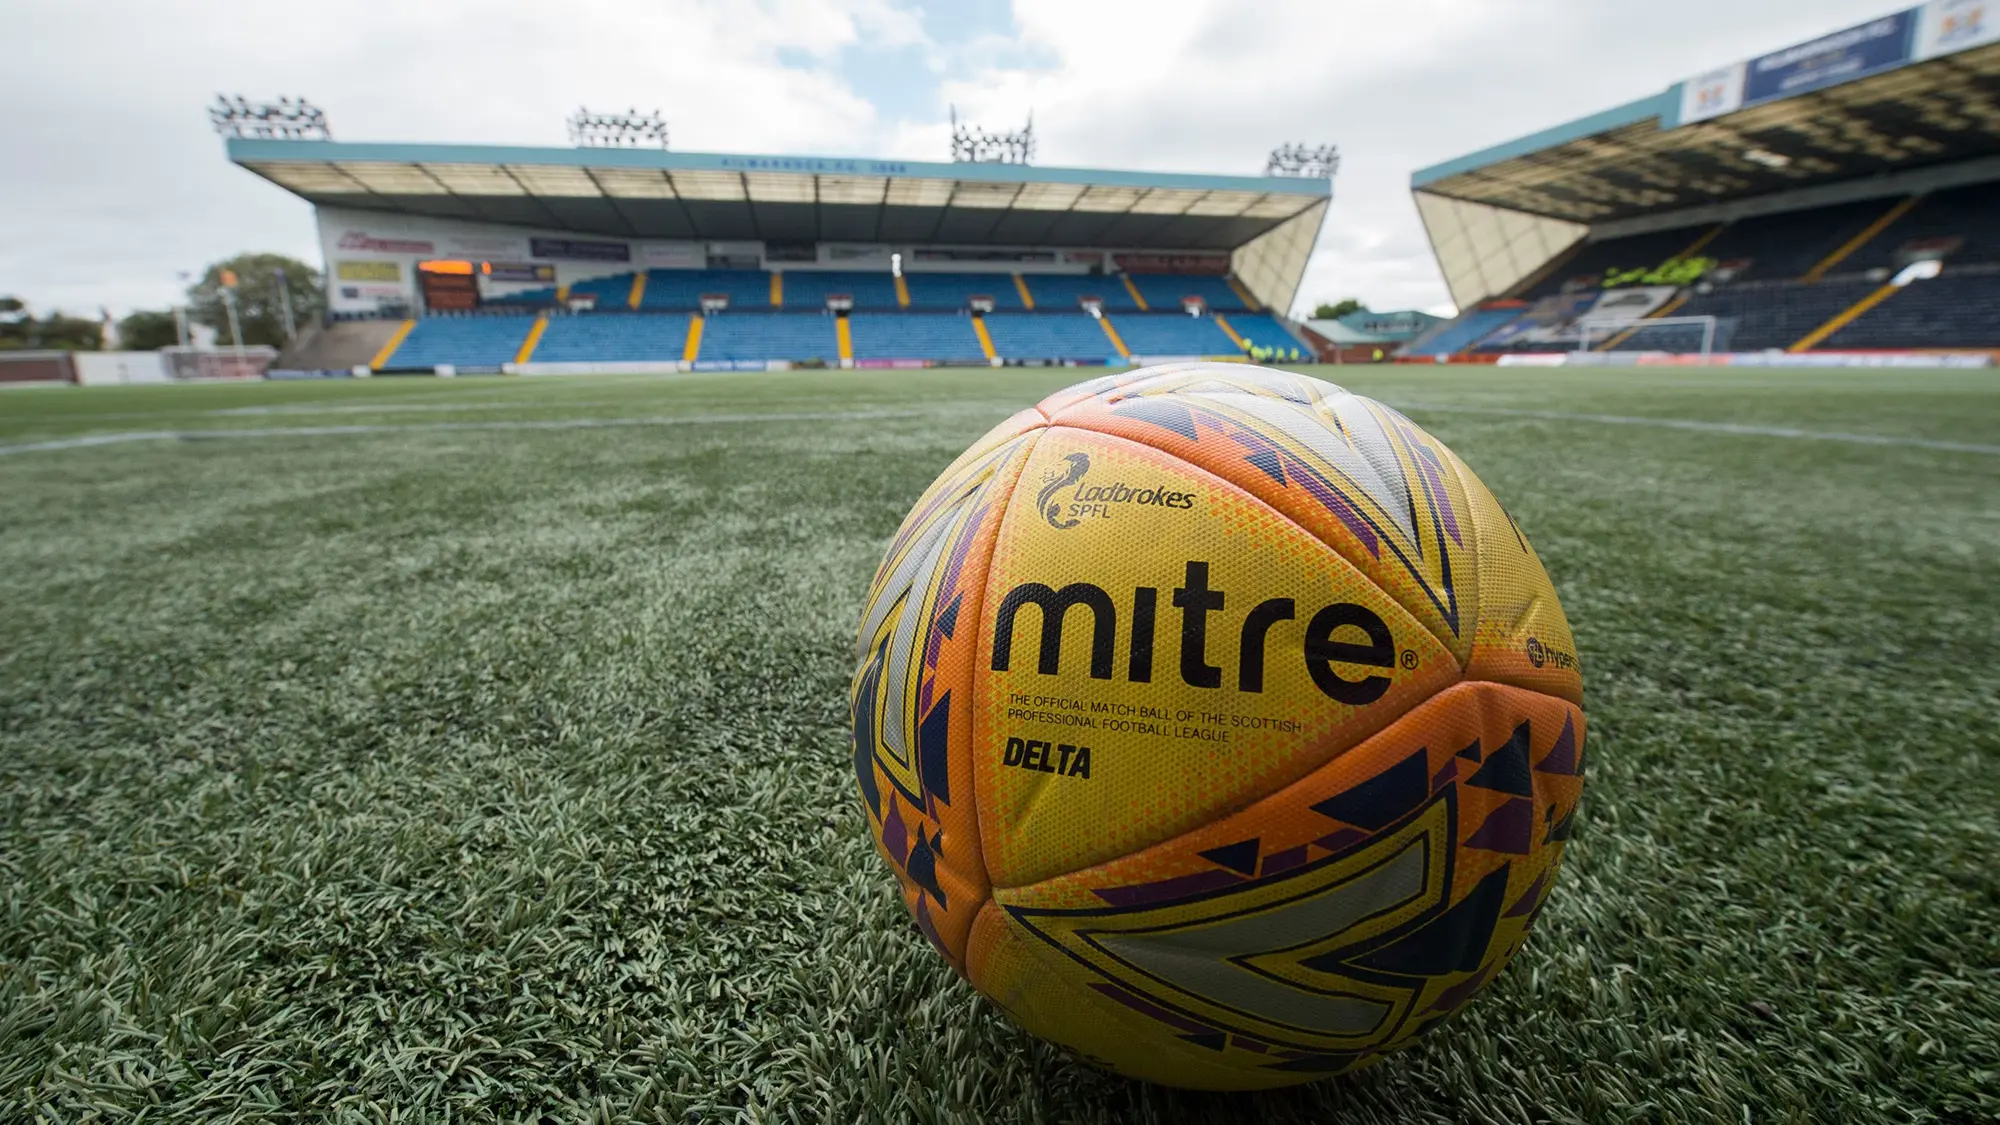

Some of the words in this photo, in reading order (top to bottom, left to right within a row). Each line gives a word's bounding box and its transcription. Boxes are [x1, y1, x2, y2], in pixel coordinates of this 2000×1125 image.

[1068, 503, 1111, 519] SPFL
[1073, 482, 1197, 510] Ladbrokes
[991, 560, 1396, 706] mitre
[1007, 708, 1098, 729] PROFESSIONAL
[1102, 718, 1170, 737] FOOTBALL
[1174, 726, 1230, 743] LEAGUE
[1010, 693, 1031, 706] THE
[1033, 695, 1086, 712] OFFICIAL
[1090, 701, 1136, 716] MATCH
[1139, 706, 1172, 721] BALL
[1176, 709, 1196, 722] OF
[1200, 712, 1227, 726] THE
[1231, 715, 1302, 733] SCOTTISH
[1003, 737, 1091, 779] DELTA
